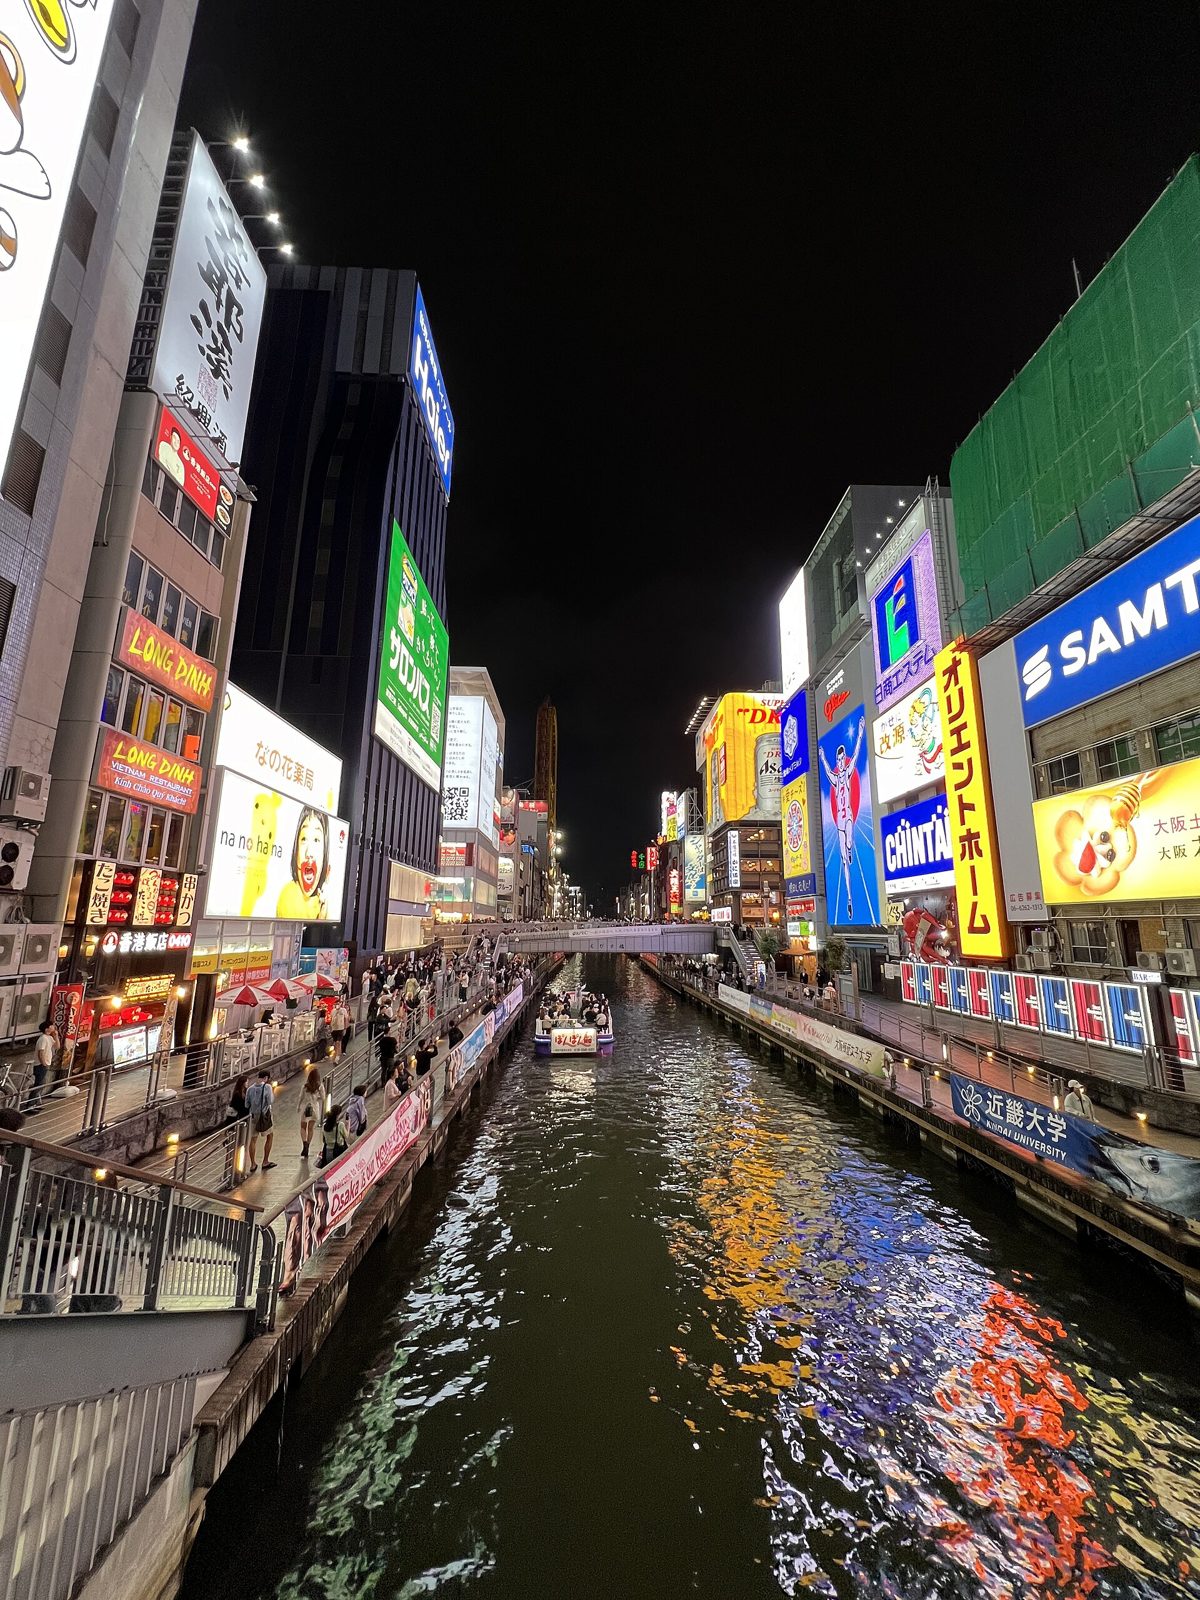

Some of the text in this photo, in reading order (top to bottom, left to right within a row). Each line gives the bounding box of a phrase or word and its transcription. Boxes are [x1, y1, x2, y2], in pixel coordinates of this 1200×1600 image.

[415, 334, 450, 475] Haier
[127, 626, 213, 697] LONG DINH
[874, 643, 936, 706] 日商エステム
[111, 761, 193, 795] VIETNAM RESTAURANT
[112, 740, 195, 785] LONG DINH
[255, 740, 315, 792] なの花薬局
[942, 655, 991, 935] オリエントホーム
[220, 829, 283, 858] na no ha na
[90, 862, 114, 924] たこ焼き
[180, 875, 196, 925] 串かつ
[119, 933, 192, 953] 香港飯店 0410
[1133, 972, 1149, 981] BAR
[985, 1091, 1068, 1143] 近畿大学
[986, 1119, 1068, 1162] KINDAI UNIVERSITY
[330, 1180, 360, 1217] Osaka
